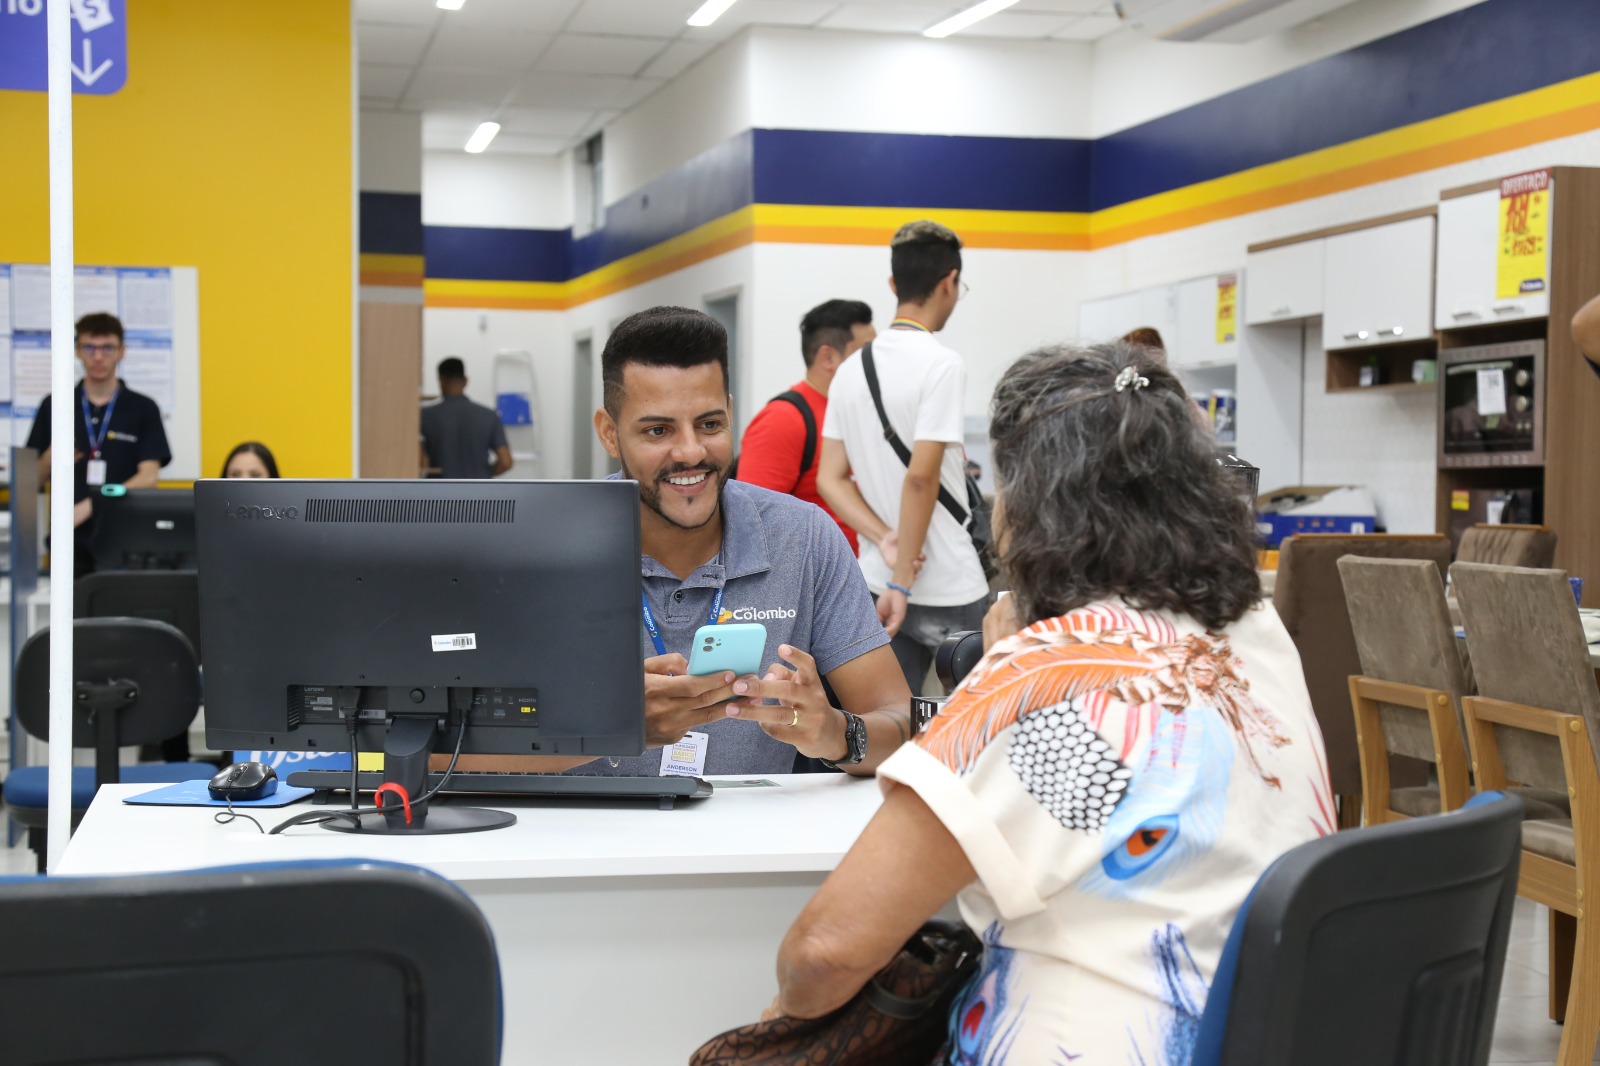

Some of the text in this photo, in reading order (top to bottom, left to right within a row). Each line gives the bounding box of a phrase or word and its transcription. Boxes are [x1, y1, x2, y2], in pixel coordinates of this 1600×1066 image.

[225, 501, 299, 520] Lenovo
[733, 607, 796, 621] Colombo
[666, 764, 698, 772] ANDERSON
